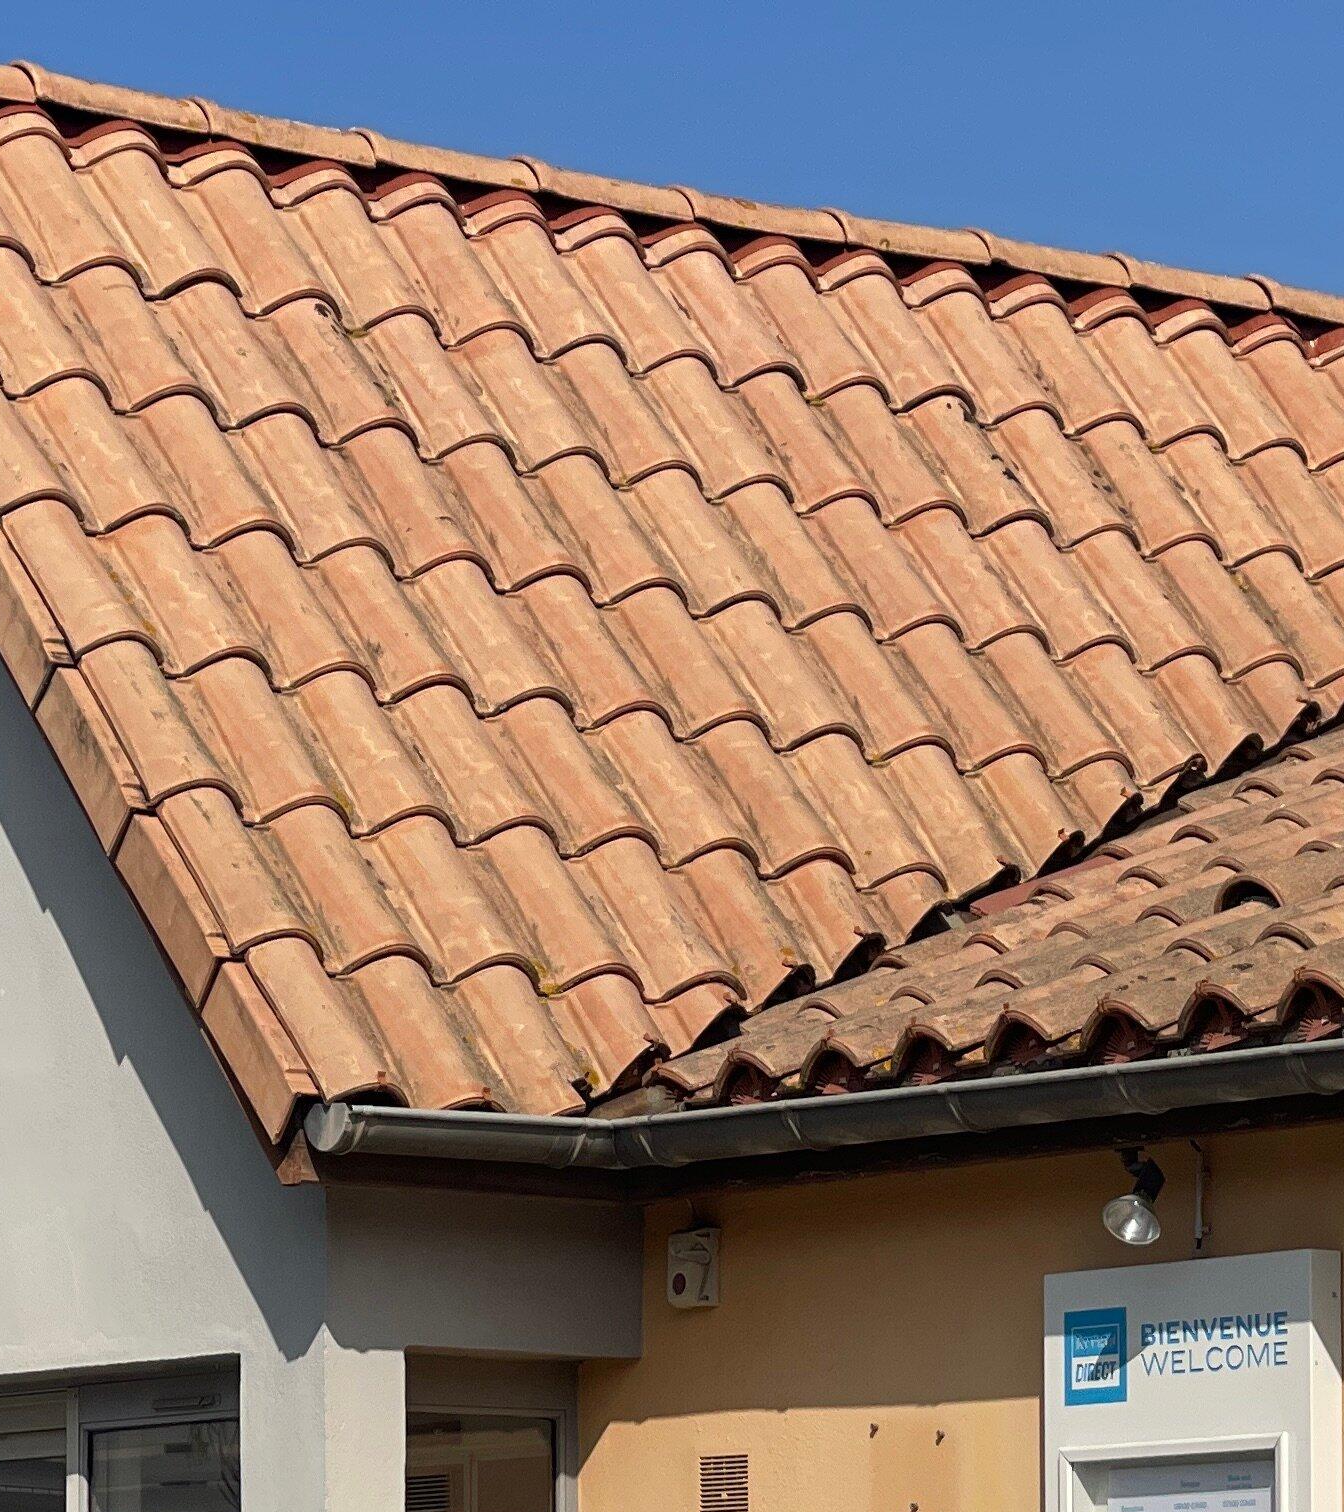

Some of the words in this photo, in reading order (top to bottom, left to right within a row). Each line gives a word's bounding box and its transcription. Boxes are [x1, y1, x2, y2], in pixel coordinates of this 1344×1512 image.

[1140, 1311, 1289, 1347] BIENVENUE
[1075, 1360, 1117, 1383] DIRECT
[1140, 1341, 1289, 1376] WELCOME
